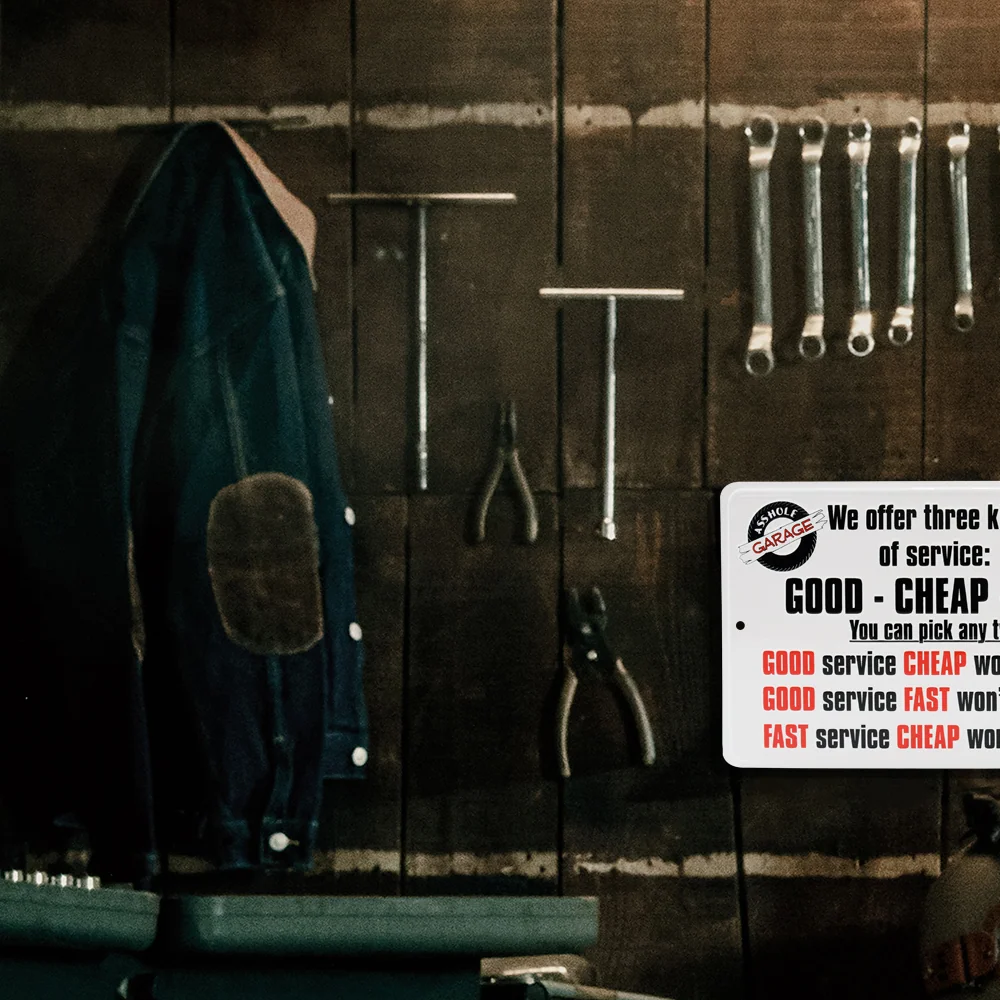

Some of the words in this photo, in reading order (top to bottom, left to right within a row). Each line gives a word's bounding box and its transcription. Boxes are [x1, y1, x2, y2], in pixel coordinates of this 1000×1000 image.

[754, 507, 798, 534] ASSHOLE
[827, 505, 858, 530] We
[866, 505, 917, 530] offer
[924, 504, 979, 530] three
[752, 518, 814, 554] GARAGE
[879, 541, 899, 566] of
[906, 541, 990, 566] service:
[786, 578, 862, 614] GOOD
[895, 578, 988, 614] CHEAP
[849, 620, 878, 640] You
[884, 623, 913, 640] can
[919, 620, 953, 643] pick
[959, 623, 987, 643] any
[763, 651, 814, 675] GOOD
[823, 651, 896, 675] service
[904, 651, 966, 675] CHEAP
[763, 686, 815, 711] GOOD
[823, 687, 896, 711] service
[904, 687, 950, 711] FAST
[764, 724, 808, 748] FAST
[816, 725, 889, 749] service
[897, 725, 959, 749] CHEAP
